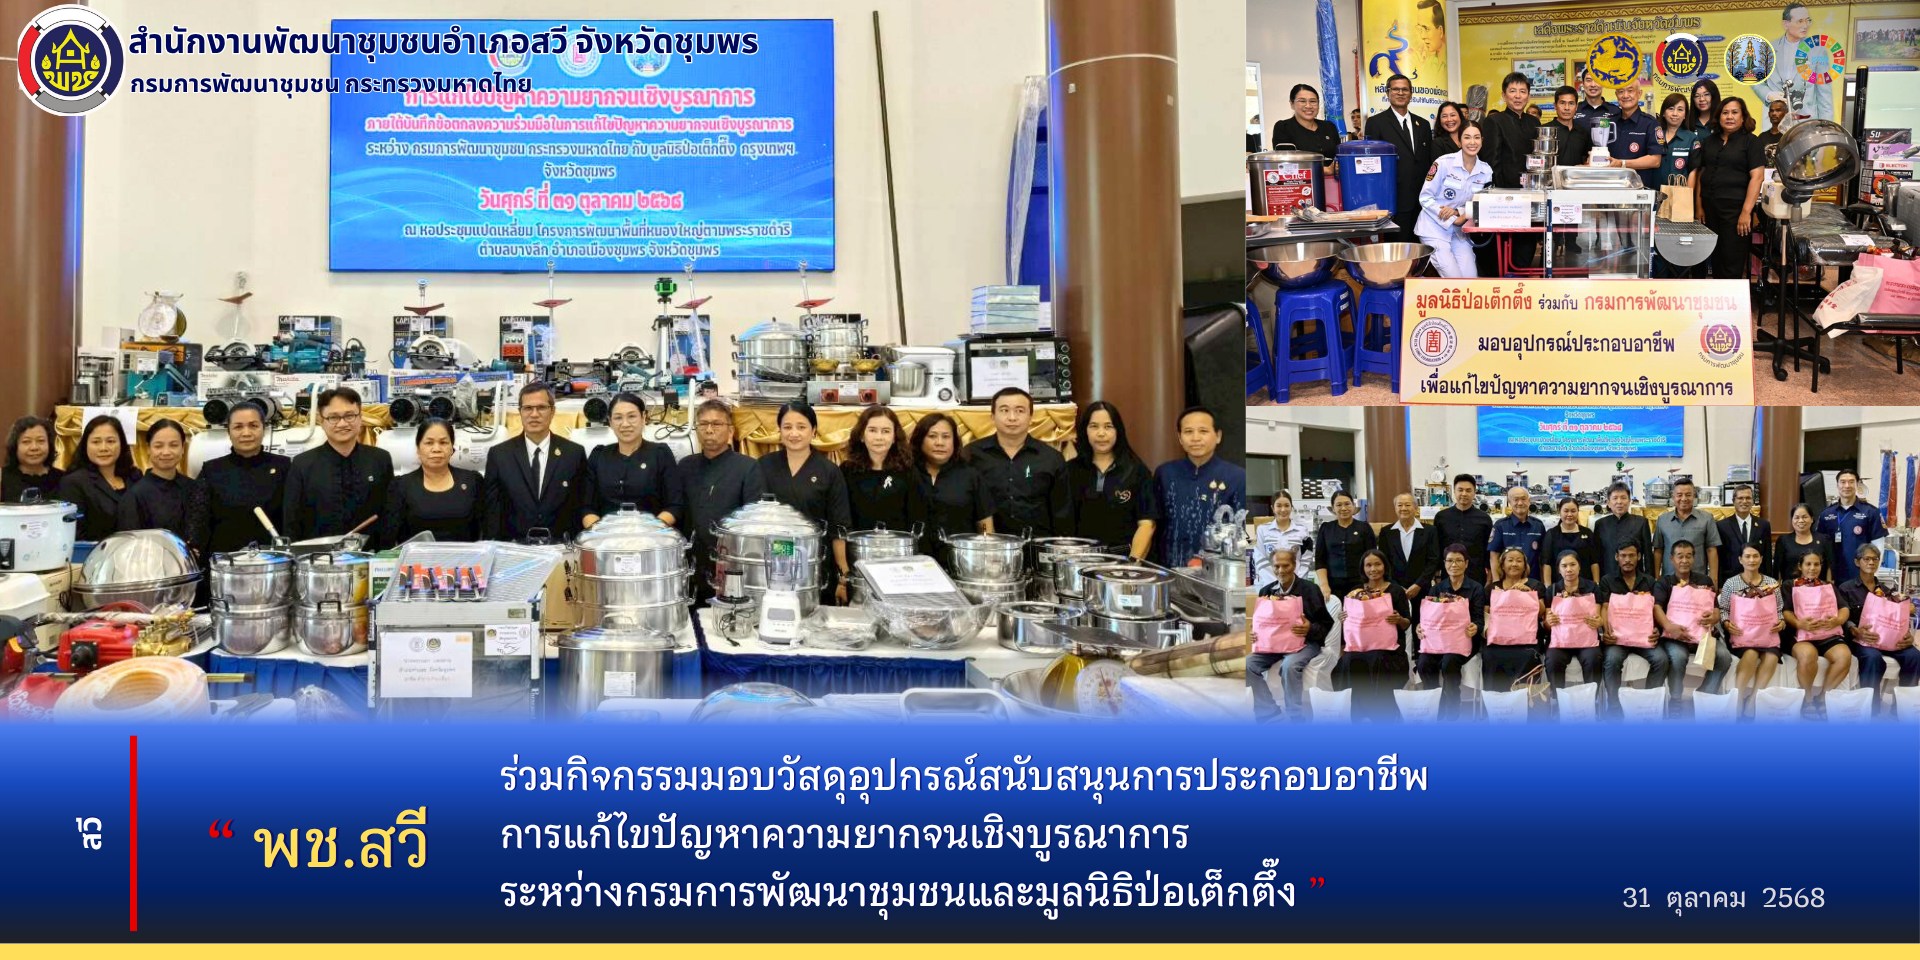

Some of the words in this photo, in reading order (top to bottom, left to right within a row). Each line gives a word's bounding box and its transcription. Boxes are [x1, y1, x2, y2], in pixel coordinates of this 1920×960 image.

[1533, 11, 1701, 37] เสด็จพระราชดำเนินจังหวัดชุมพร
[404, 85, 754, 112] การแกไขปญหาความยากจนเชิงบูรณาการ
[367, 139, 408, 155] ระหว่าง
[413, 140, 525, 159] กรมการพัฒนาชุมชน
[528, 141, 627, 156] กระทรวงมหาดไทย
[632, 141, 648, 155] กับ
[544, 163, 615, 181] จังหวัดชุมพร
[479, 189, 534, 213] วันศุกร์
[538, 184, 550, 208] ที่
[553, 194, 574, 208] ๓๑
[579, 194, 632, 213] ตุลาคม
[404, 226, 415, 237] ณ
[419, 218, 533, 240] หอประชุมแปดเหลี่ยม
[479, 242, 548, 256] ตำบลบางลึก
[551, 242, 645, 260] อำเภอเมืองชุมพร
[649, 243, 720, 260] จังหวัดชุมพร
[1415, 282, 1533, 318] มูลนิธิป่อเต็กตึ๊ง
[1538, 293, 1579, 311] ร่วมกับ
[1584, 288, 1738, 319] กรมการพัฒนาชุมชน
[1478, 330, 1676, 360] มอบอุปกรณ์ประกอบอาชีพ
[1420, 367, 1734, 404] เพื่อแก้ไขปัญหาความยากจนเชิงบูรณาการ
